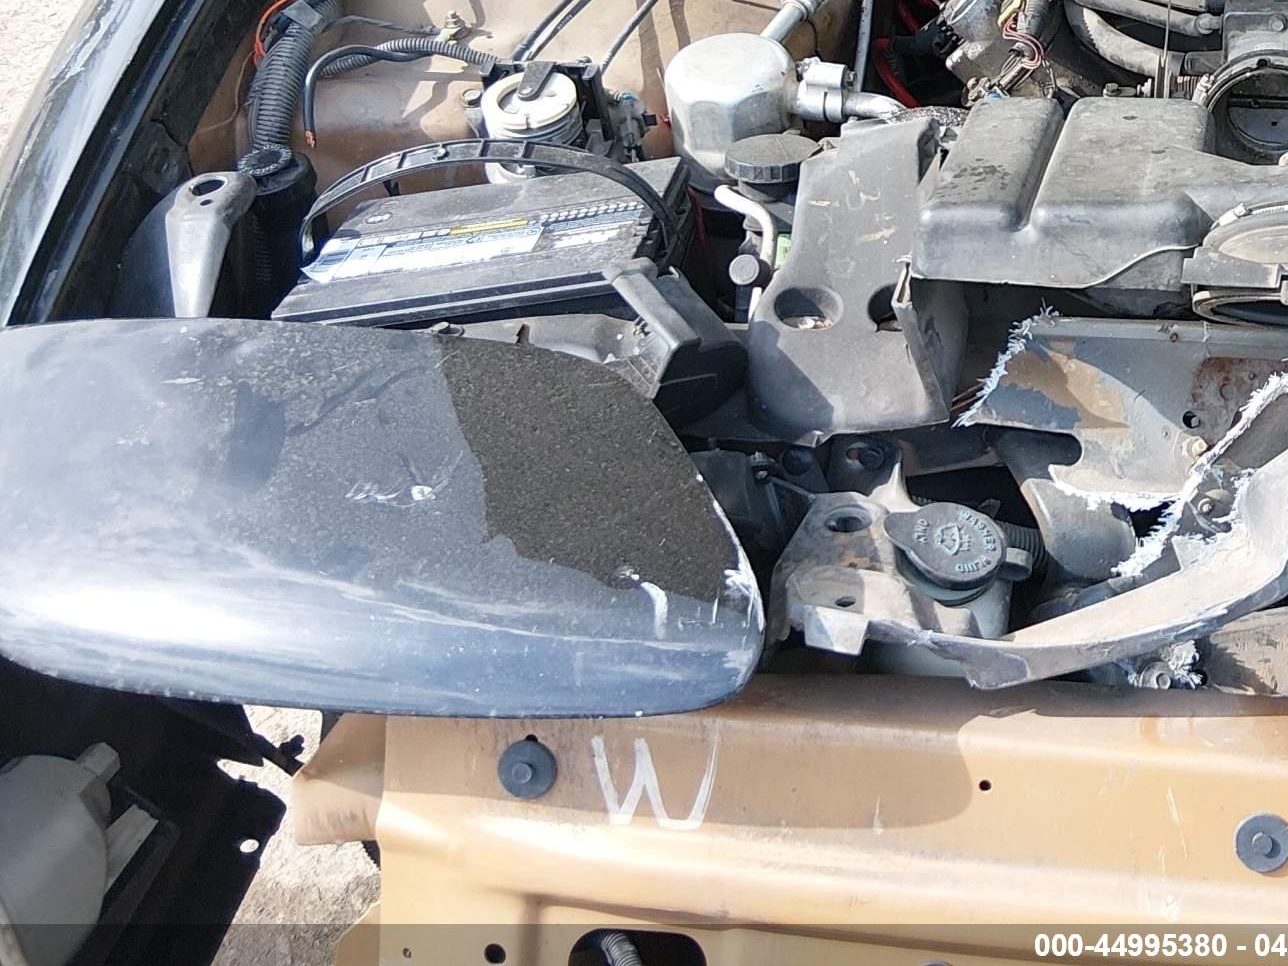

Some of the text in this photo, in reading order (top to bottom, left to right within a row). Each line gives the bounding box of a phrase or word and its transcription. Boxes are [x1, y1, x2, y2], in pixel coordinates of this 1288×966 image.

[911, 510, 997, 574] WASHER FLUID ONLY
